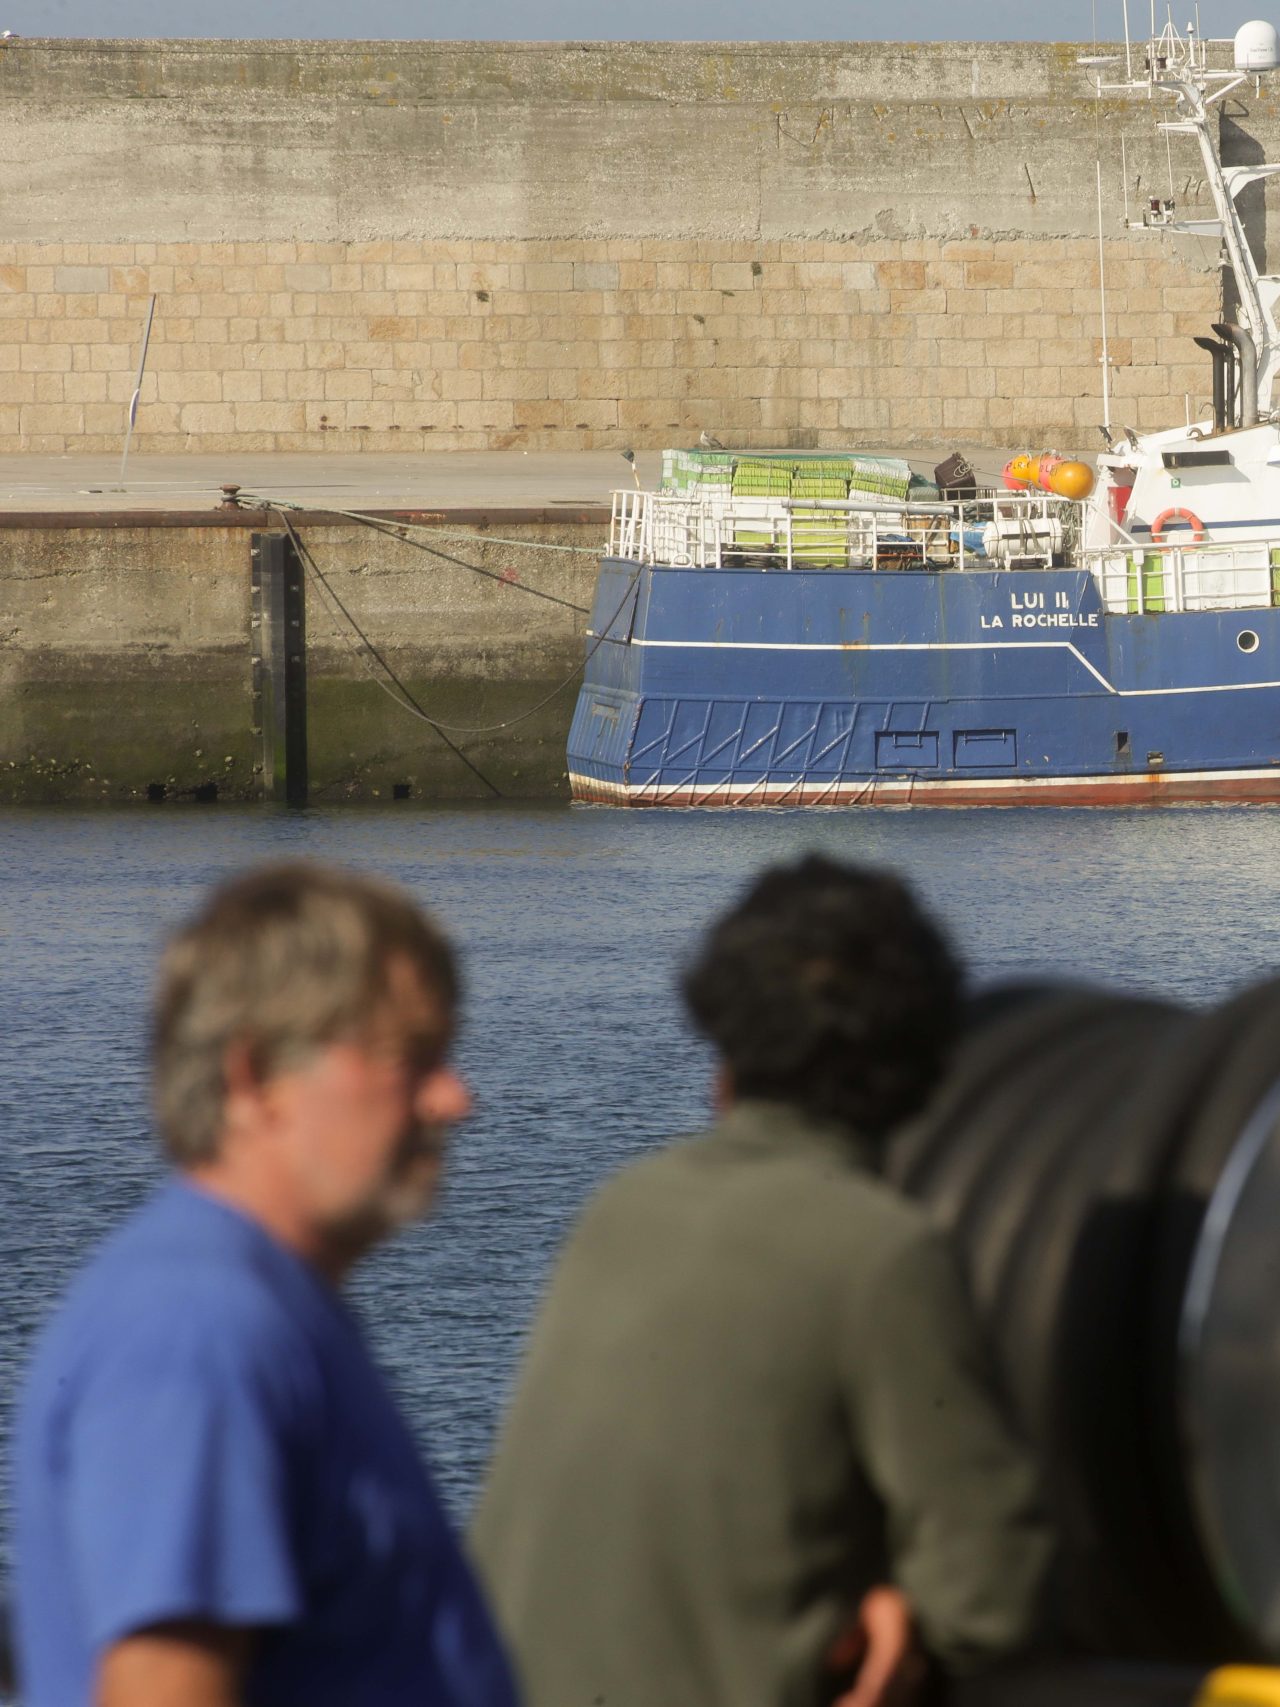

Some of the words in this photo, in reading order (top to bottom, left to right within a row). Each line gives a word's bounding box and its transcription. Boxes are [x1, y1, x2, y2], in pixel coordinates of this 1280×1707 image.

[1011, 592, 1044, 609] LUI
[1055, 591, 1069, 609] II
[980, 615, 1003, 628] LA
[1012, 613, 1099, 628] ROCHELLE
